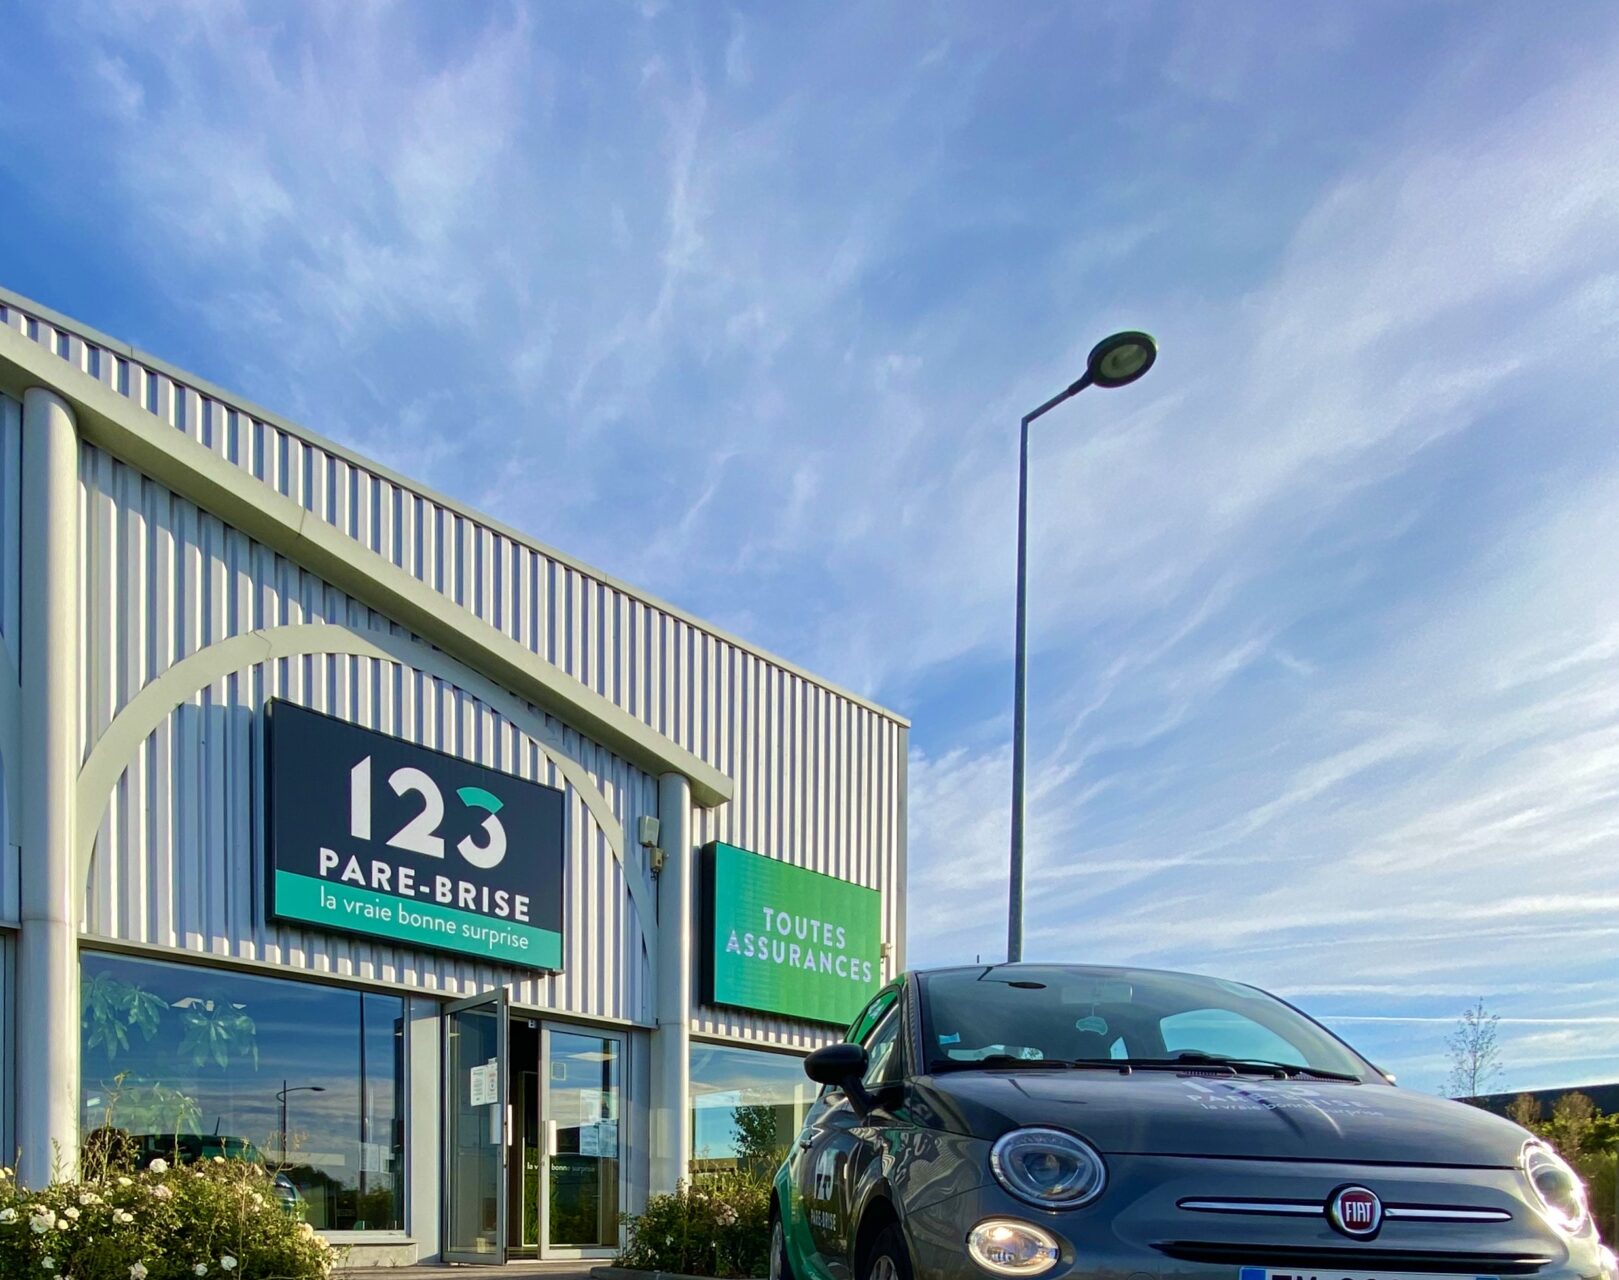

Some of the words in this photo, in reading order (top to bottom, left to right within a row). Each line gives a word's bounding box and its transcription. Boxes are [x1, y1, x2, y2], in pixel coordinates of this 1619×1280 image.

[350, 754, 508, 869] 123
[319, 847, 530, 922] PARE-BRISE
[320, 885, 337, 910] la
[344, 899, 392, 922] vraie
[398, 903, 457, 935] bonne
[462, 922, 529, 950] surprise
[763, 906, 846, 949] TOUTES
[726, 929, 872, 983] ASSURANCES
[1345, 1201, 1372, 1223] FIAT
